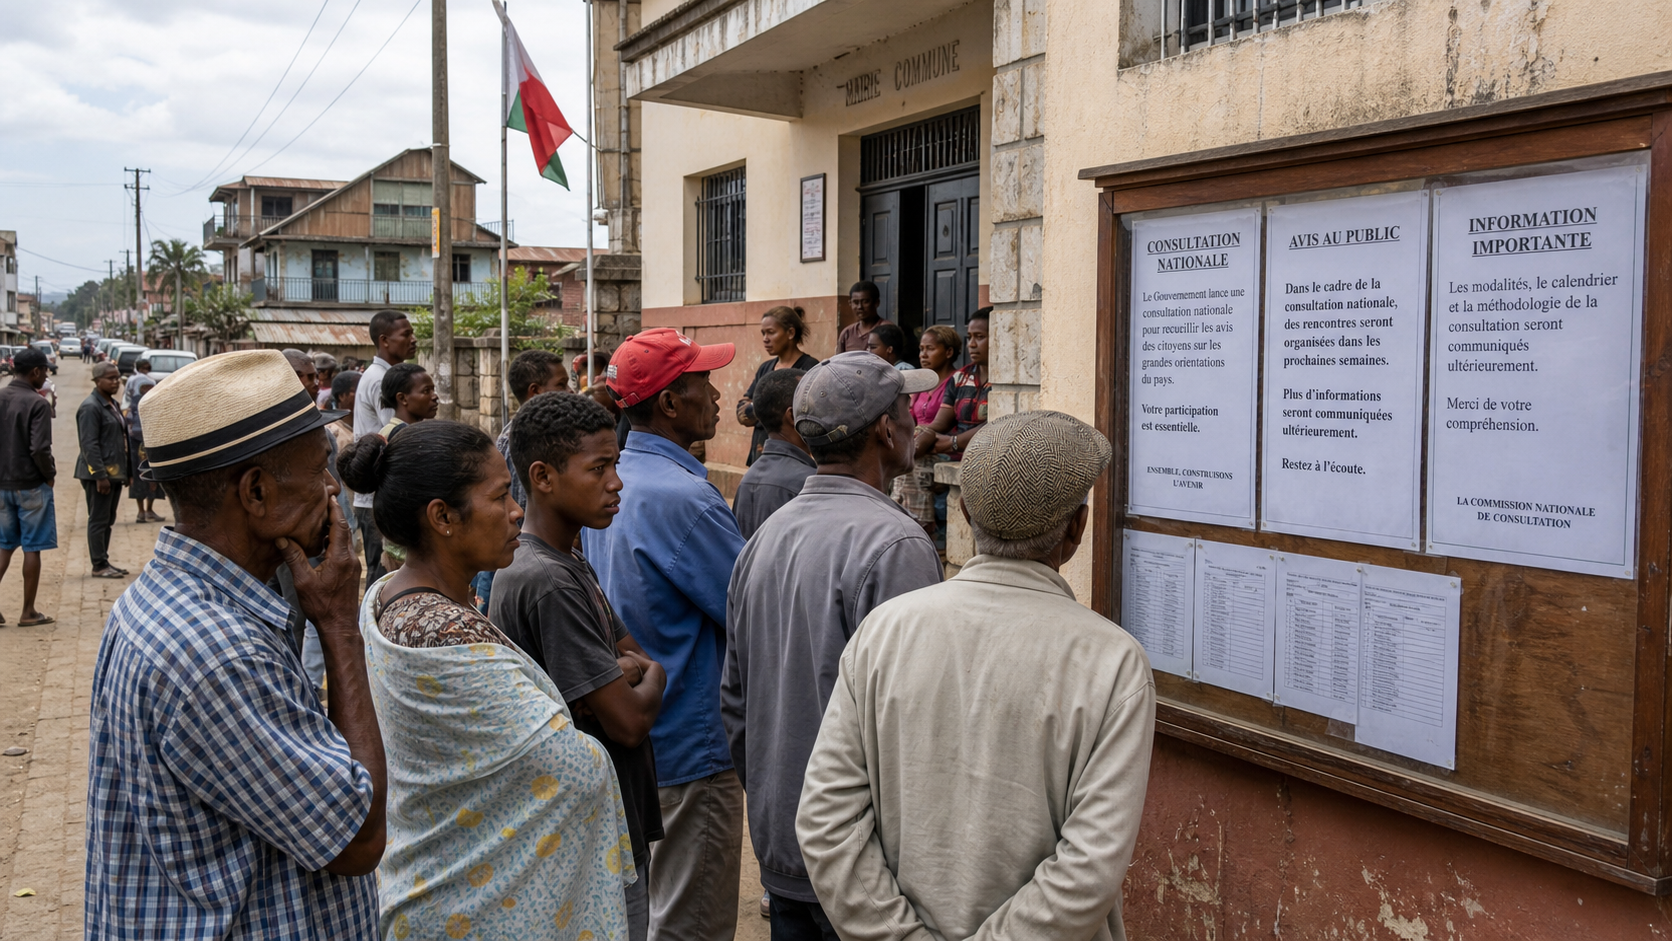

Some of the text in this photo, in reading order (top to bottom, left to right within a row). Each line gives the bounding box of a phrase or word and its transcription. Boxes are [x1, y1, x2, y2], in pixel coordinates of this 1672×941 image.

[846, 39, 960, 107] MAIRIE COMMUNE
[1468, 207, 1597, 232] INFORMATION
[1147, 232, 1240, 253] CONSULTATION
[1289, 225, 1400, 248] AVIS AU PUBLIC
[1472, 232, 1592, 255] IMPORTANTE
[1157, 253, 1229, 271] NATIONALE
[1285, 278, 1380, 294] Dans le cadre de la
[1449, 273, 1618, 293] Les modalités, le calendrier
[1143, 288, 1245, 302] Le Gouvernement lance une
[1143, 303, 1233, 319] consultation nationale
[1285, 296, 1397, 312] consultation nationale,
[1449, 294, 1597, 313] et la méthodologie de la
[1142, 321, 1233, 338] pour recueillir les avis
[1284, 317, 1393, 330] des rencontres seront
[1449, 319, 1563, 332] consultation seront
[1142, 339, 1221, 353] des citoyens sur les
[1284, 335, 1380, 350] organisées dans les
[1448, 338, 1529, 355] communiqués
[1142, 357, 1225, 370] grandes orientations
[1284, 354, 1389, 369] prochaines semaines.
[1448, 359, 1538, 371] ultérieurement.
[1142, 374, 1174, 387] du pays.
[1283, 388, 1381, 401] Plus d'informations
[1142, 404, 1218, 418] Votre participation
[1447, 397, 1531, 411] Merci de votre
[1283, 408, 1392, 423] seront communiquées
[1141, 422, 1200, 432] est essentielle.
[1283, 424, 1357, 438] ultérieurement.
[1446, 417, 1538, 433] compréhension.
[1282, 458, 1365, 474] Restez à l'écoute.
[1182, 469, 1233, 480] CONSTRUISONS
[1457, 497, 1596, 518] LA COMMISSION NATIONALE
[1478, 512, 1571, 529] DE CONSULTATION
